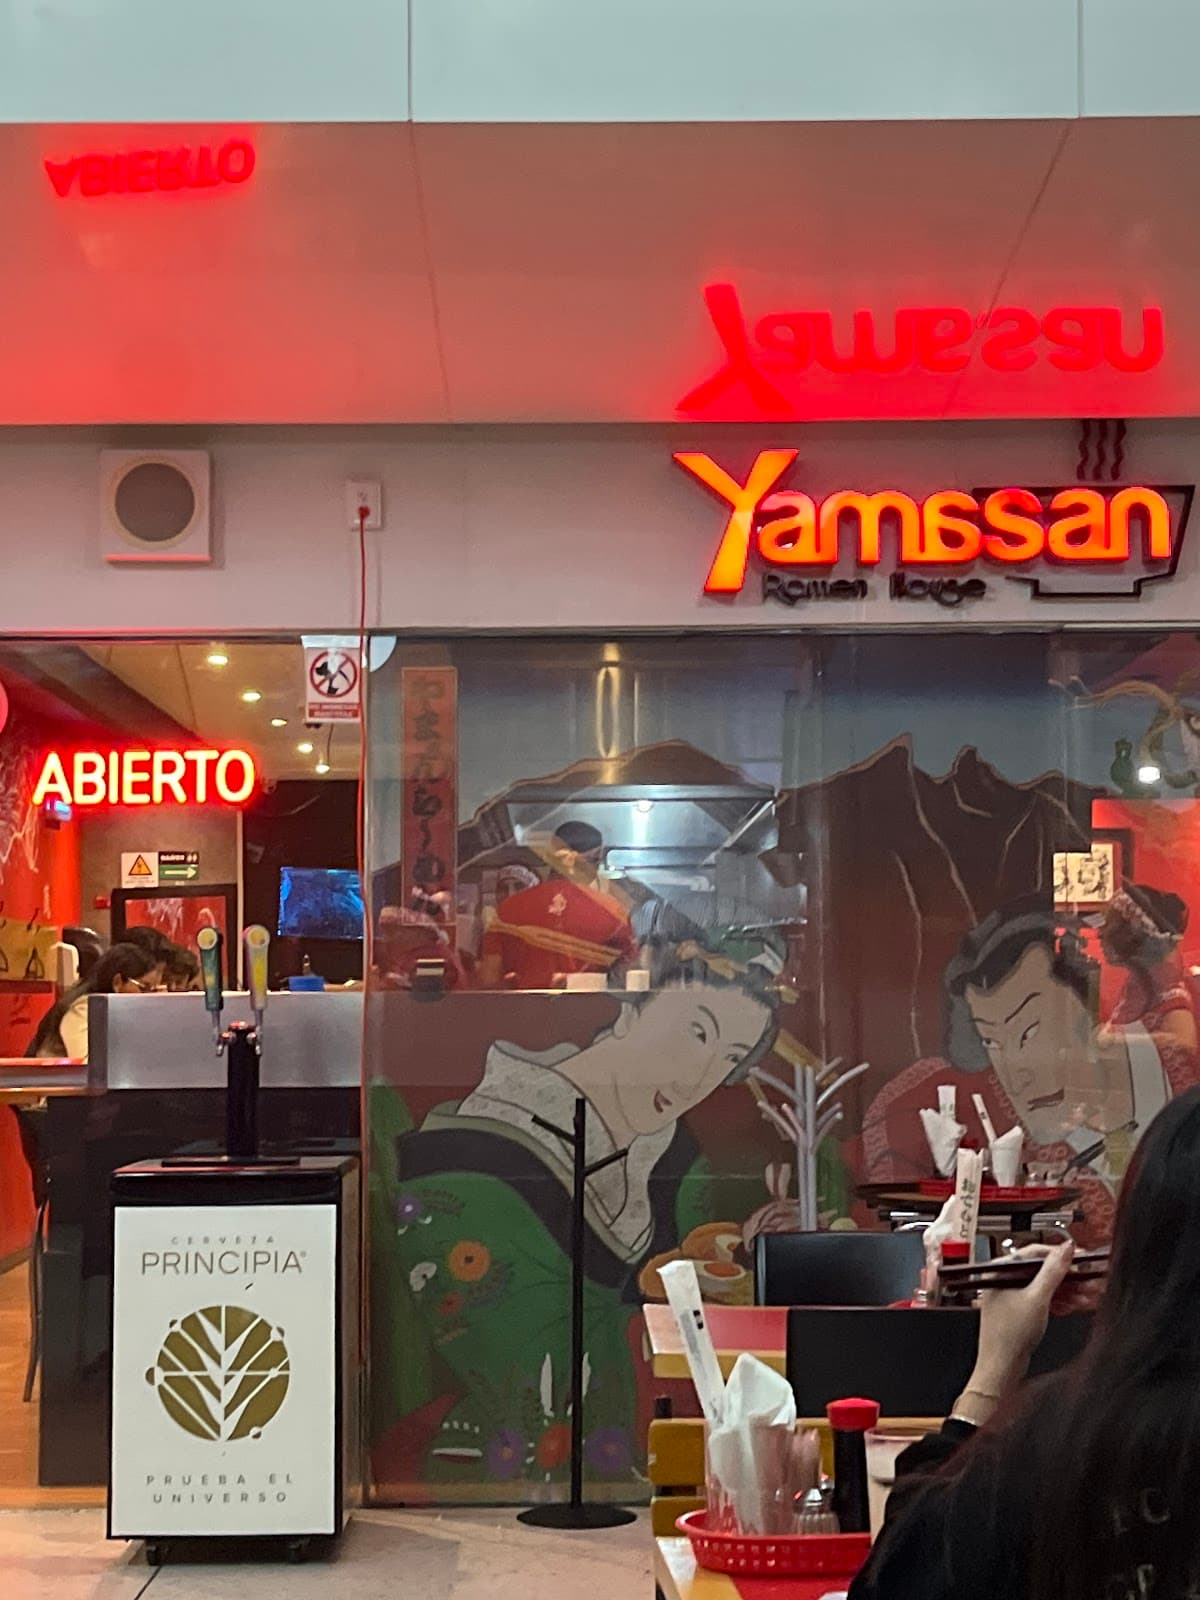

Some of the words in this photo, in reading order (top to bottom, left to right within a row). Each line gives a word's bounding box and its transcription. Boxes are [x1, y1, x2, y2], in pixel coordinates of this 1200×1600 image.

[32, 749, 255, 805] ABIERTO
[141, 1250, 303, 1276] PRINCIPIA
[146, 1473, 246, 1486] PRUEBA
[268, 1472, 293, 1485] EL
[152, 1491, 288, 1504] UNIVERSO
